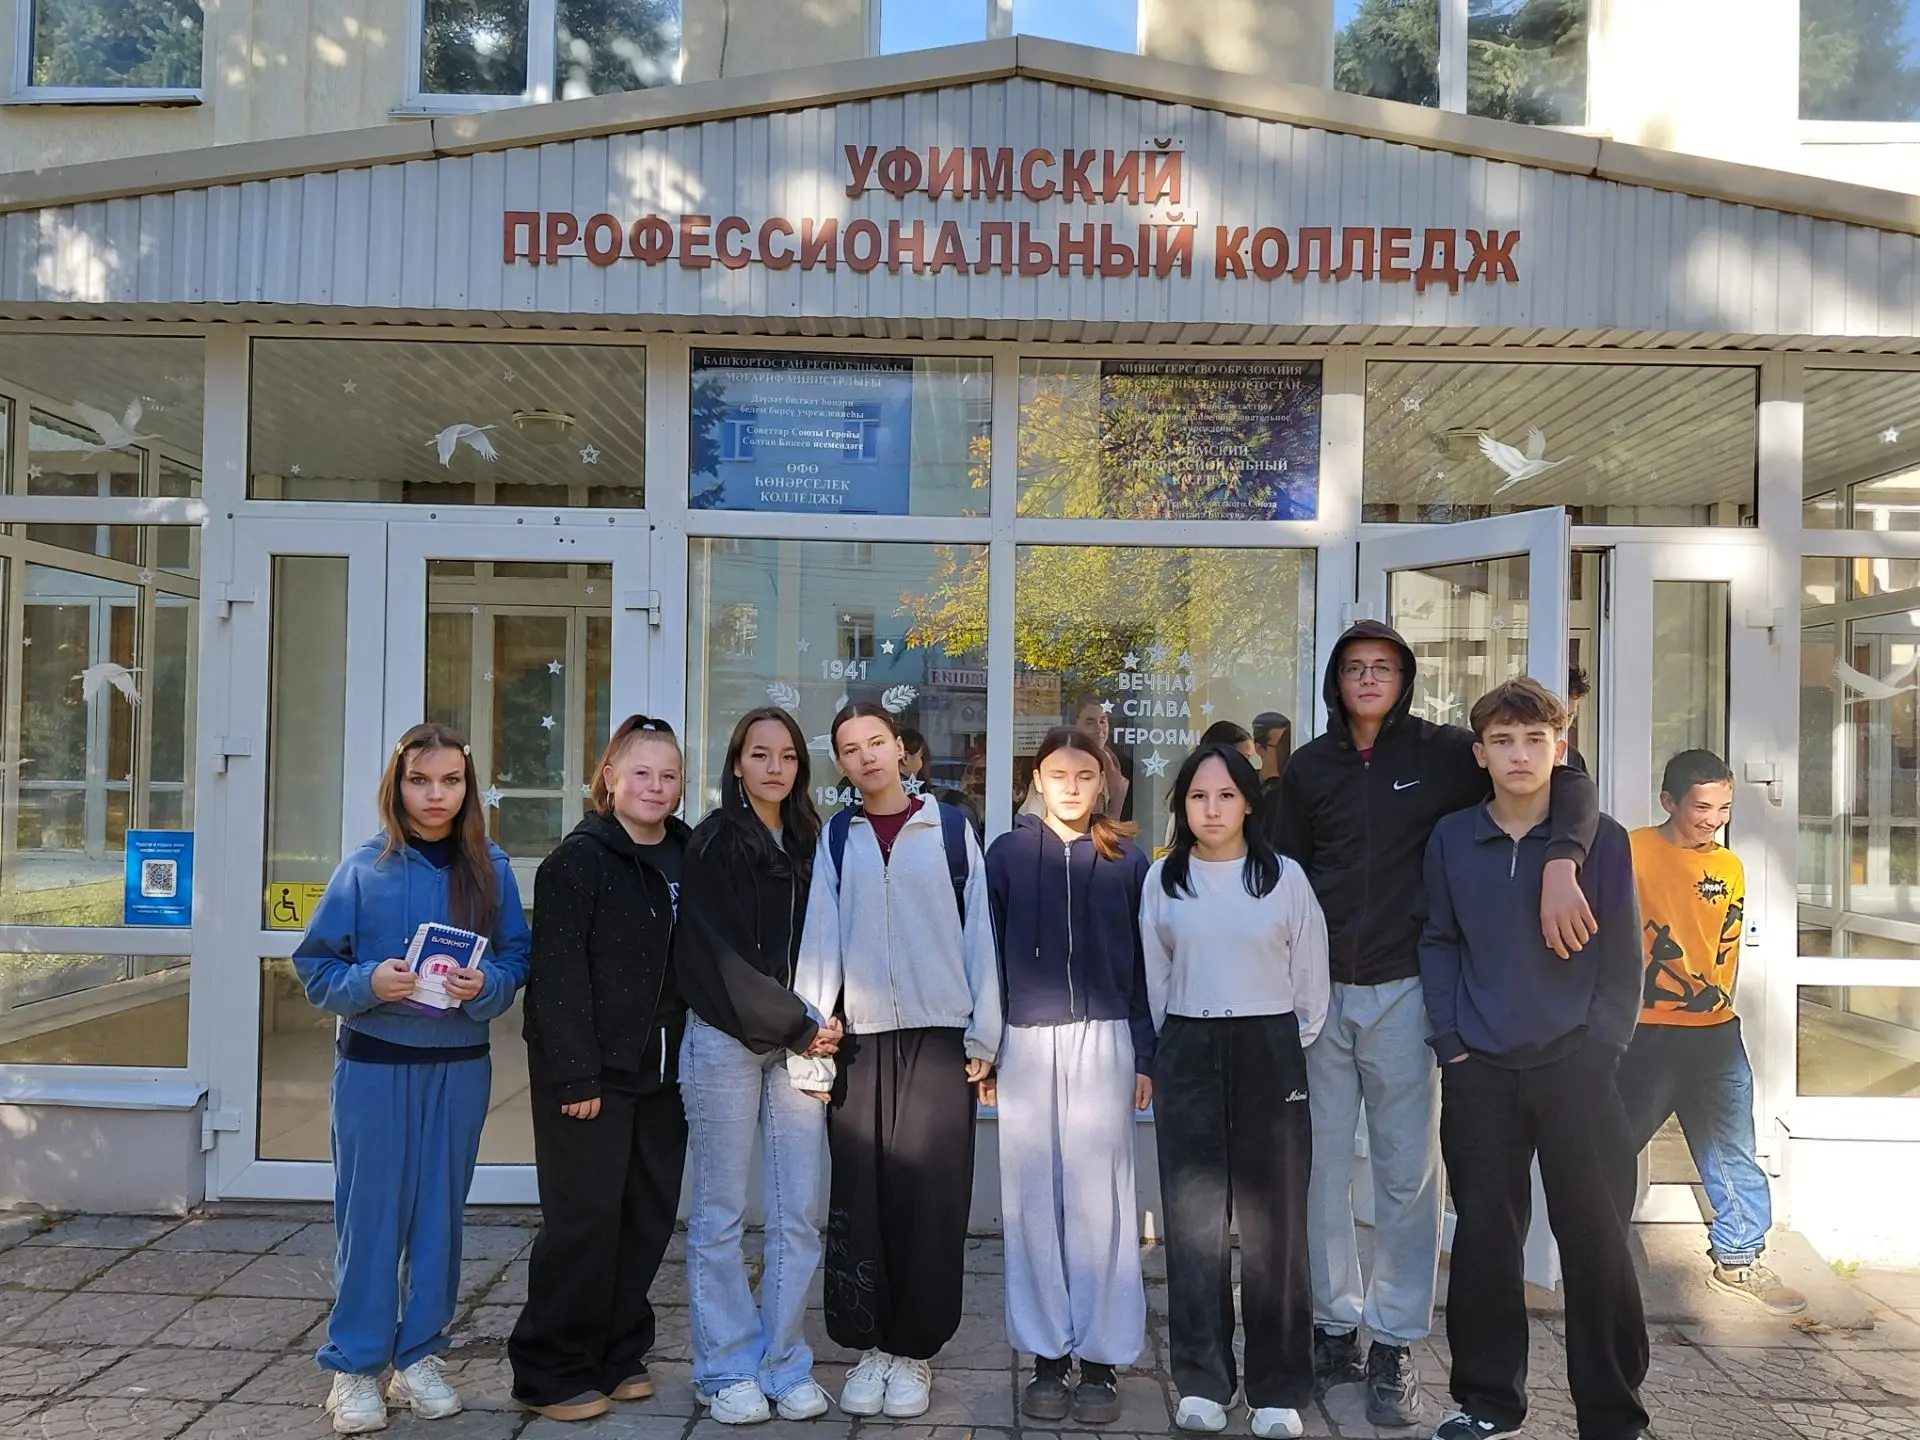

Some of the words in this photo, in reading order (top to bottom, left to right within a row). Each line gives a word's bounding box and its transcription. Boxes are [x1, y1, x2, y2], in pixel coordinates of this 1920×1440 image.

[844, 138, 1183, 206] УФИМСКИЙ
[503, 211, 1195, 278] ПРОФЕССИОНАЛЬНЫЙ
[1215, 225, 1521, 292] КОЛЛЕДЖ
[1119, 364, 1217, 375] МИНИСТЕРСТВО
[1219, 365, 1302, 376] ОБРАЗОВАНИЯ
[821, 659, 867, 680] 1941
[1119, 672, 1197, 692] ВЕЧНАЯ
[1123, 699, 1192, 717] СЛАВА
[431, 936, 470, 949] БЛОКНОТ
